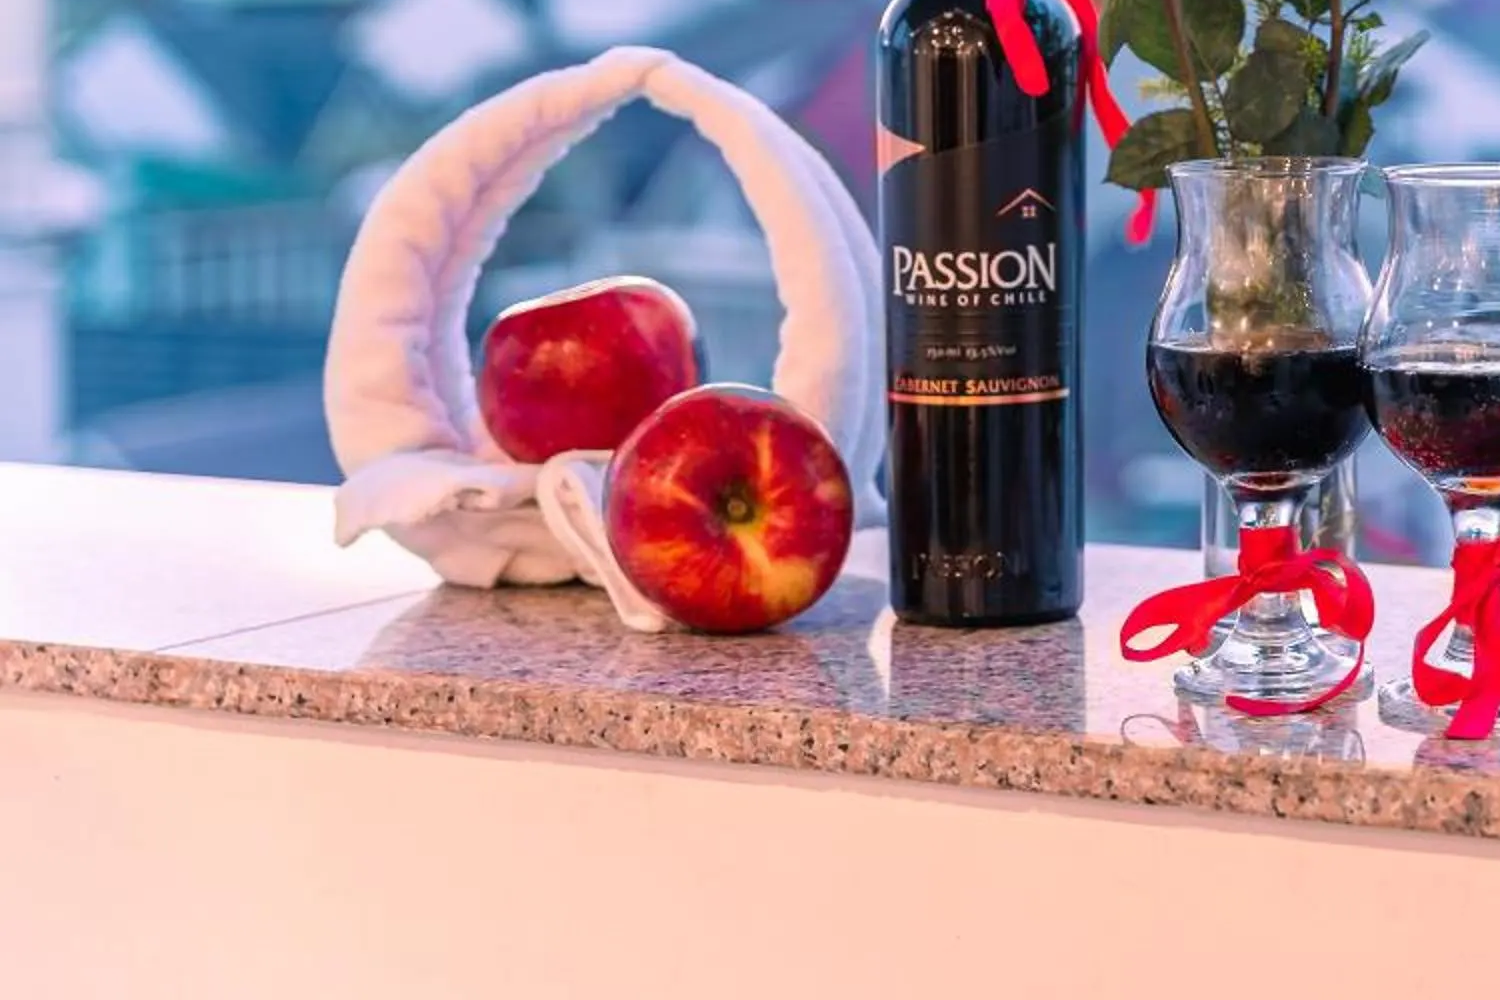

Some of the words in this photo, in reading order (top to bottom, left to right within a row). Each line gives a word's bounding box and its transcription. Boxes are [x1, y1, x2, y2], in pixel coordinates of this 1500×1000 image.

[893, 242, 1056, 296] PASSION
[905, 294, 948, 306] WINE
[957, 293, 981, 306] OF
[991, 290, 1047, 306] CHILE
[895, 378, 958, 393] CABERNET
[965, 376, 1060, 393] SAUVIGNON
